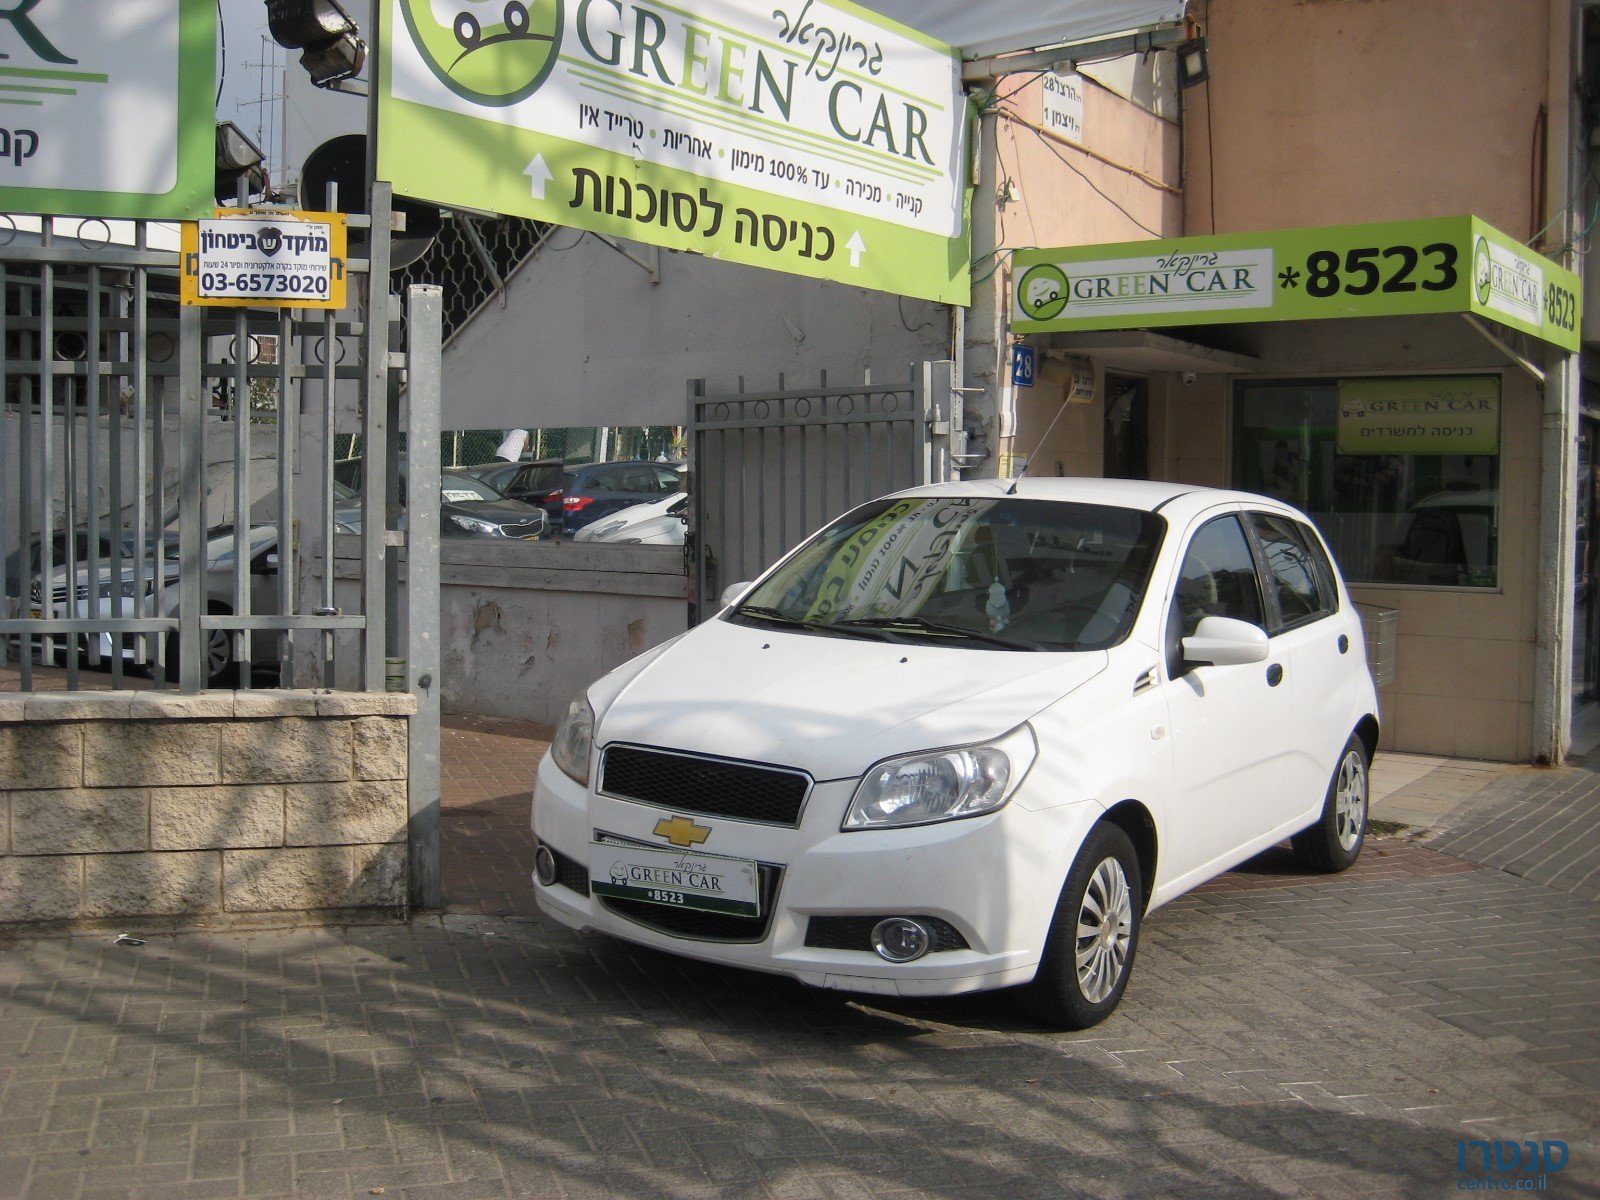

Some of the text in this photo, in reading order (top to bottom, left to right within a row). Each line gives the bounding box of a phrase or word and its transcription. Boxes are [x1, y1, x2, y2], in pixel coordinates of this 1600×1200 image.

[772, 0, 883, 81] גרינקאר
[576, 0, 935, 166] GREEN CAR
[1044, 107, 1049, 120] 1
[1052, 109, 1074, 131] ויצמן
[579, 103, 923, 218] קנייה מכירה עד 100% מימון אחריות טרייד אין
[568, 167, 835, 262] כניסה לסוכנות
[220, 260, 229, 268] 24
[201, 272, 328, 294] 03-6573020
[1073, 268, 1255, 299] GREEN CAR
[1492, 265, 1538, 306] GREEN CAR
[1015, 353, 1032, 378] 28
[1369, 399, 1491, 411] GREEN CAR
[1360, 425, 1474, 437] כניסה למשרדים
[630, 866, 722, 891] GREEN CAR
